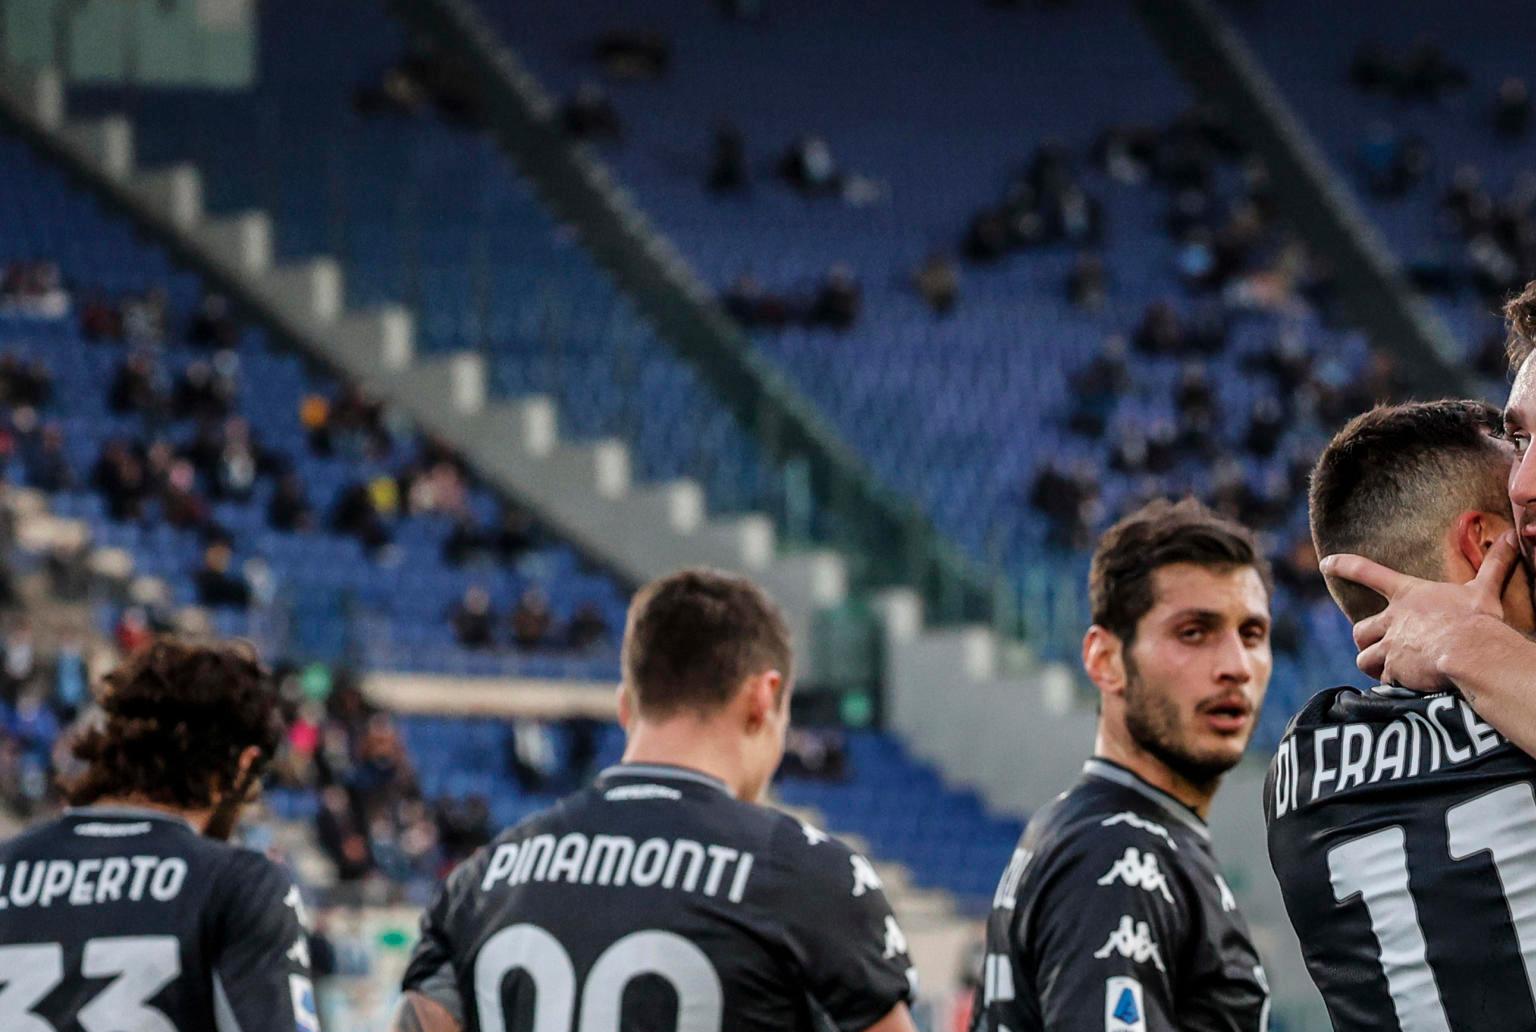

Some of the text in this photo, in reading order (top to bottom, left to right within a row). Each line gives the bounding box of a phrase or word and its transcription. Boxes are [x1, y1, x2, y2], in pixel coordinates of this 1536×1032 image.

[1276, 696, 1509, 819] DI FRANCE
[481, 832, 753, 904] PINAMONTI
